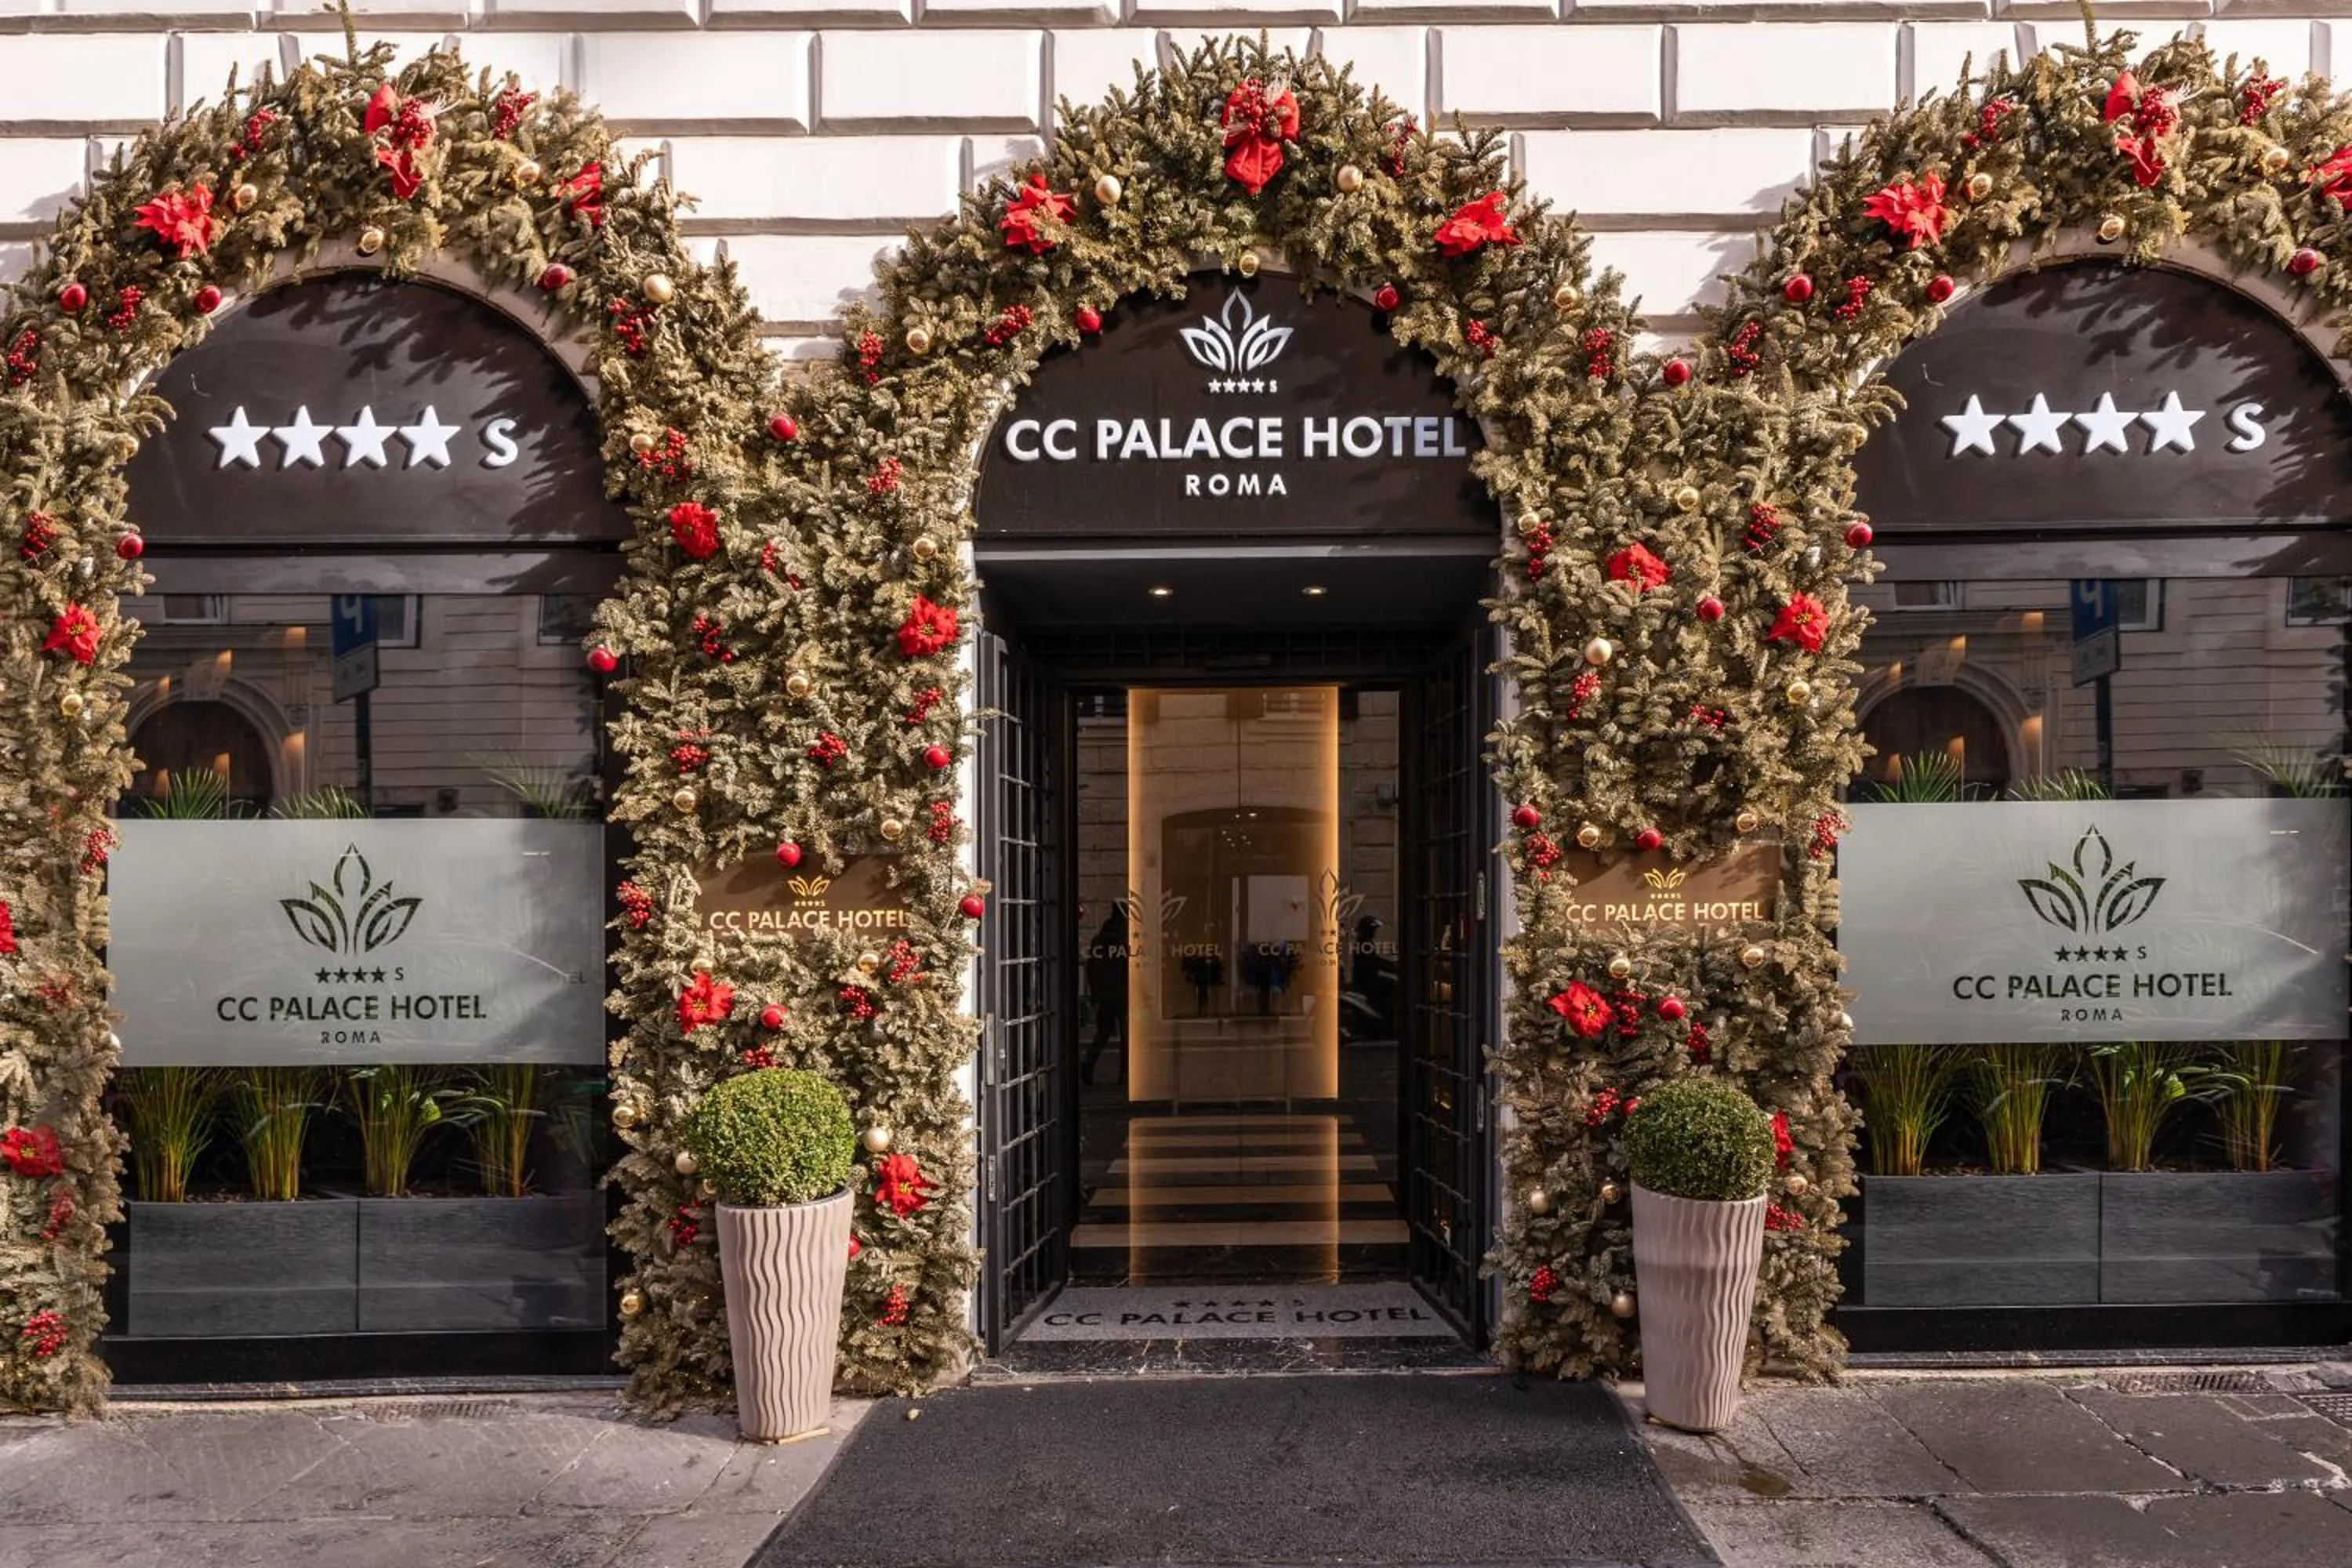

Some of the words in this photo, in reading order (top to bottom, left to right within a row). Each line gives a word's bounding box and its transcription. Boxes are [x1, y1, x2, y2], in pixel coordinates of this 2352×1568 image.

[1269, 379, 1277, 393] S
[2230, 401, 2266, 451] S
[484, 418, 518, 466] S
[1005, 419, 1077, 461] CC
[1098, 416, 1283, 460] PALACE
[1303, 416, 1467, 458] HOTEL
[1185, 474, 1287, 496] ROMA
[710, 911, 741, 929] CC
[749, 910, 831, 929] PALACE
[838, 909, 909, 928] HOTEL
[1566, 904, 1596, 923] CC
[1605, 902, 1686, 921] PALACE
[1693, 902, 1764, 920] HOTEL
[2138, 946, 2147, 960] S
[394, 967, 405, 982] S
[1953, 976, 1996, 1000] CC
[2008, 975, 2120, 999] PALACE
[2133, 973, 2233, 997] HOTEL
[217, 997, 258, 1022] CC
[270, 996, 379, 1020] PALACE
[391, 995, 486, 1019] HOTEL
[2061, 1009, 2123, 1022] ROMA
[321, 1031, 381, 1044] ROMA
[1044, 1312, 1098, 1326] CC
[1120, 1310, 1276, 1326] PALACE
[1295, 1307, 1432, 1323] HOTEL
